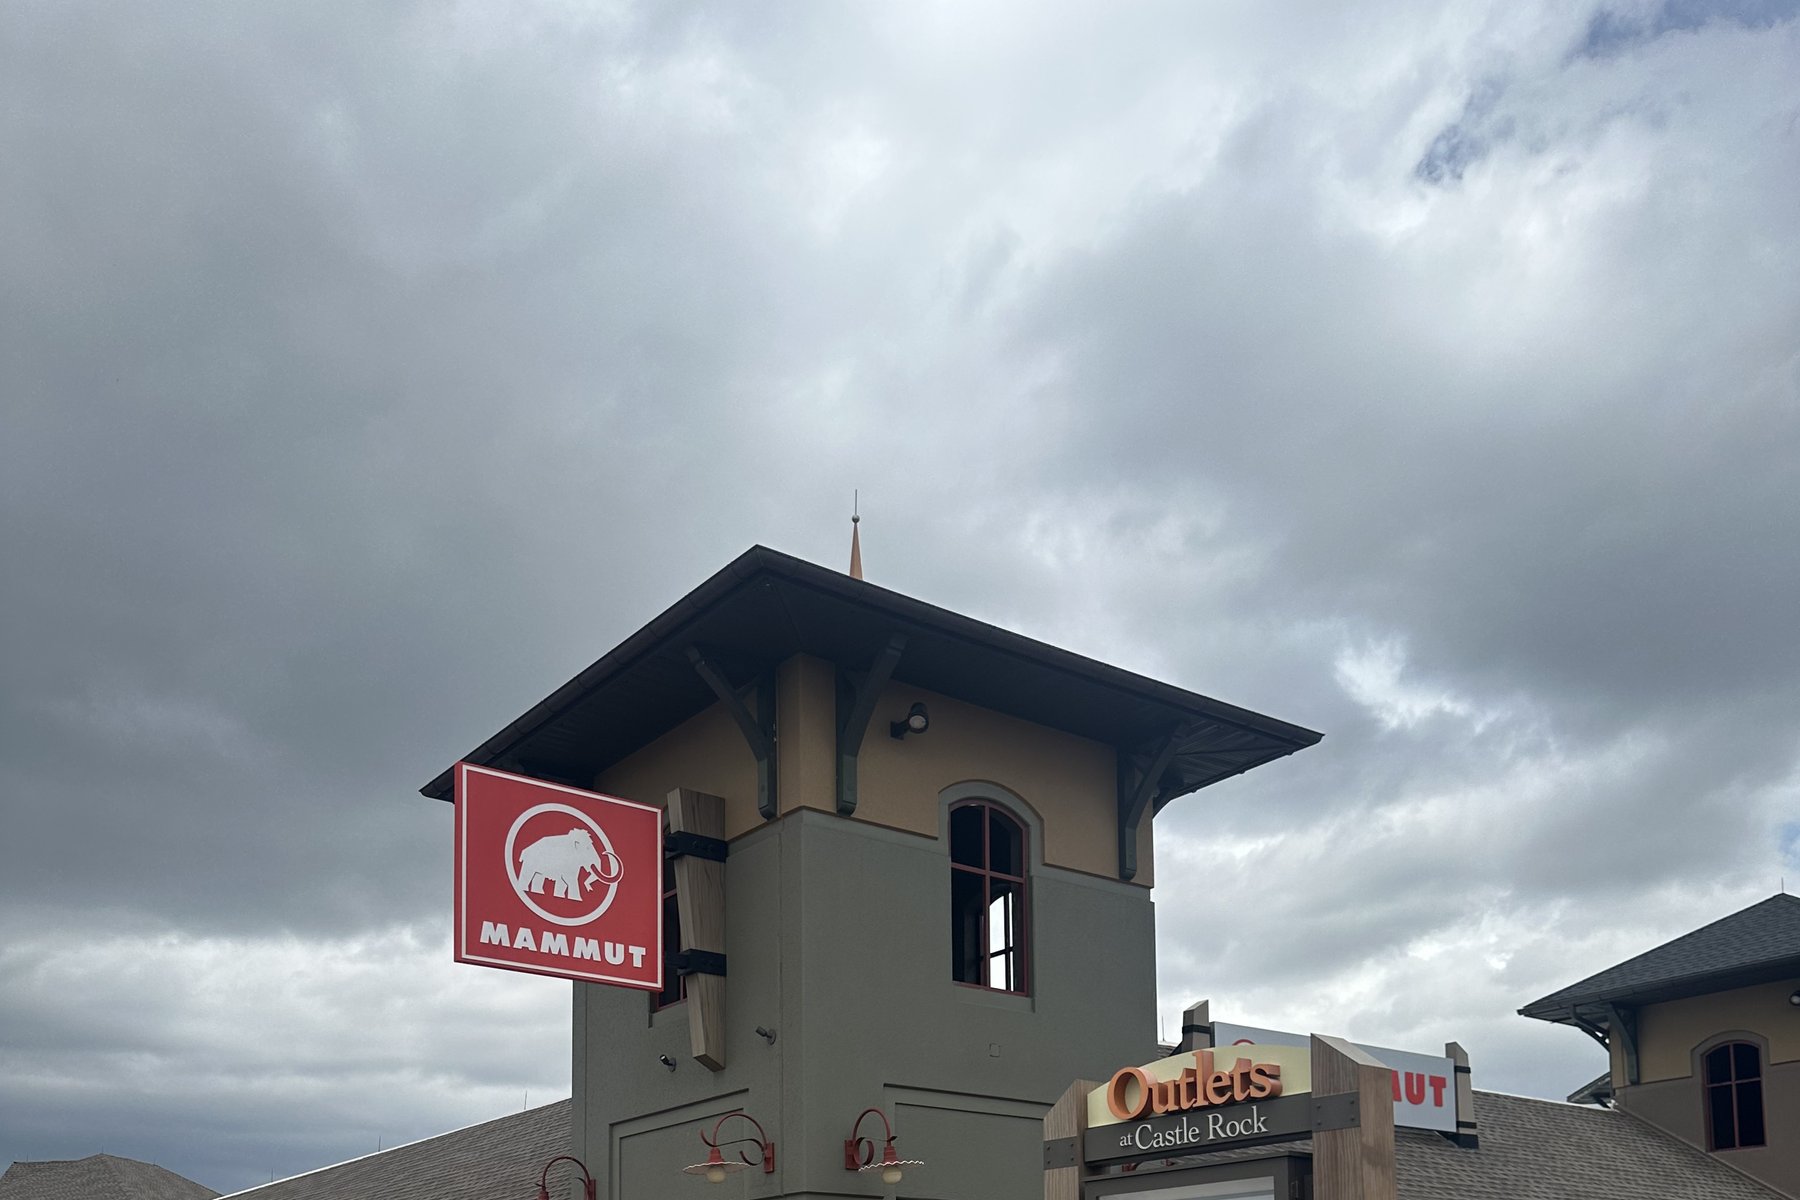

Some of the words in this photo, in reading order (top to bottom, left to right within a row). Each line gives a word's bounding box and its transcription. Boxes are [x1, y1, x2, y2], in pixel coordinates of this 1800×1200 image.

[479, 920, 647, 968] MAMMUT
[1107, 1050, 1283, 1121] Outlets
[1119, 1132, 1133, 1147] at
[1135, 1116, 1200, 1150] Castle
[1207, 1105, 1268, 1140] Rock
